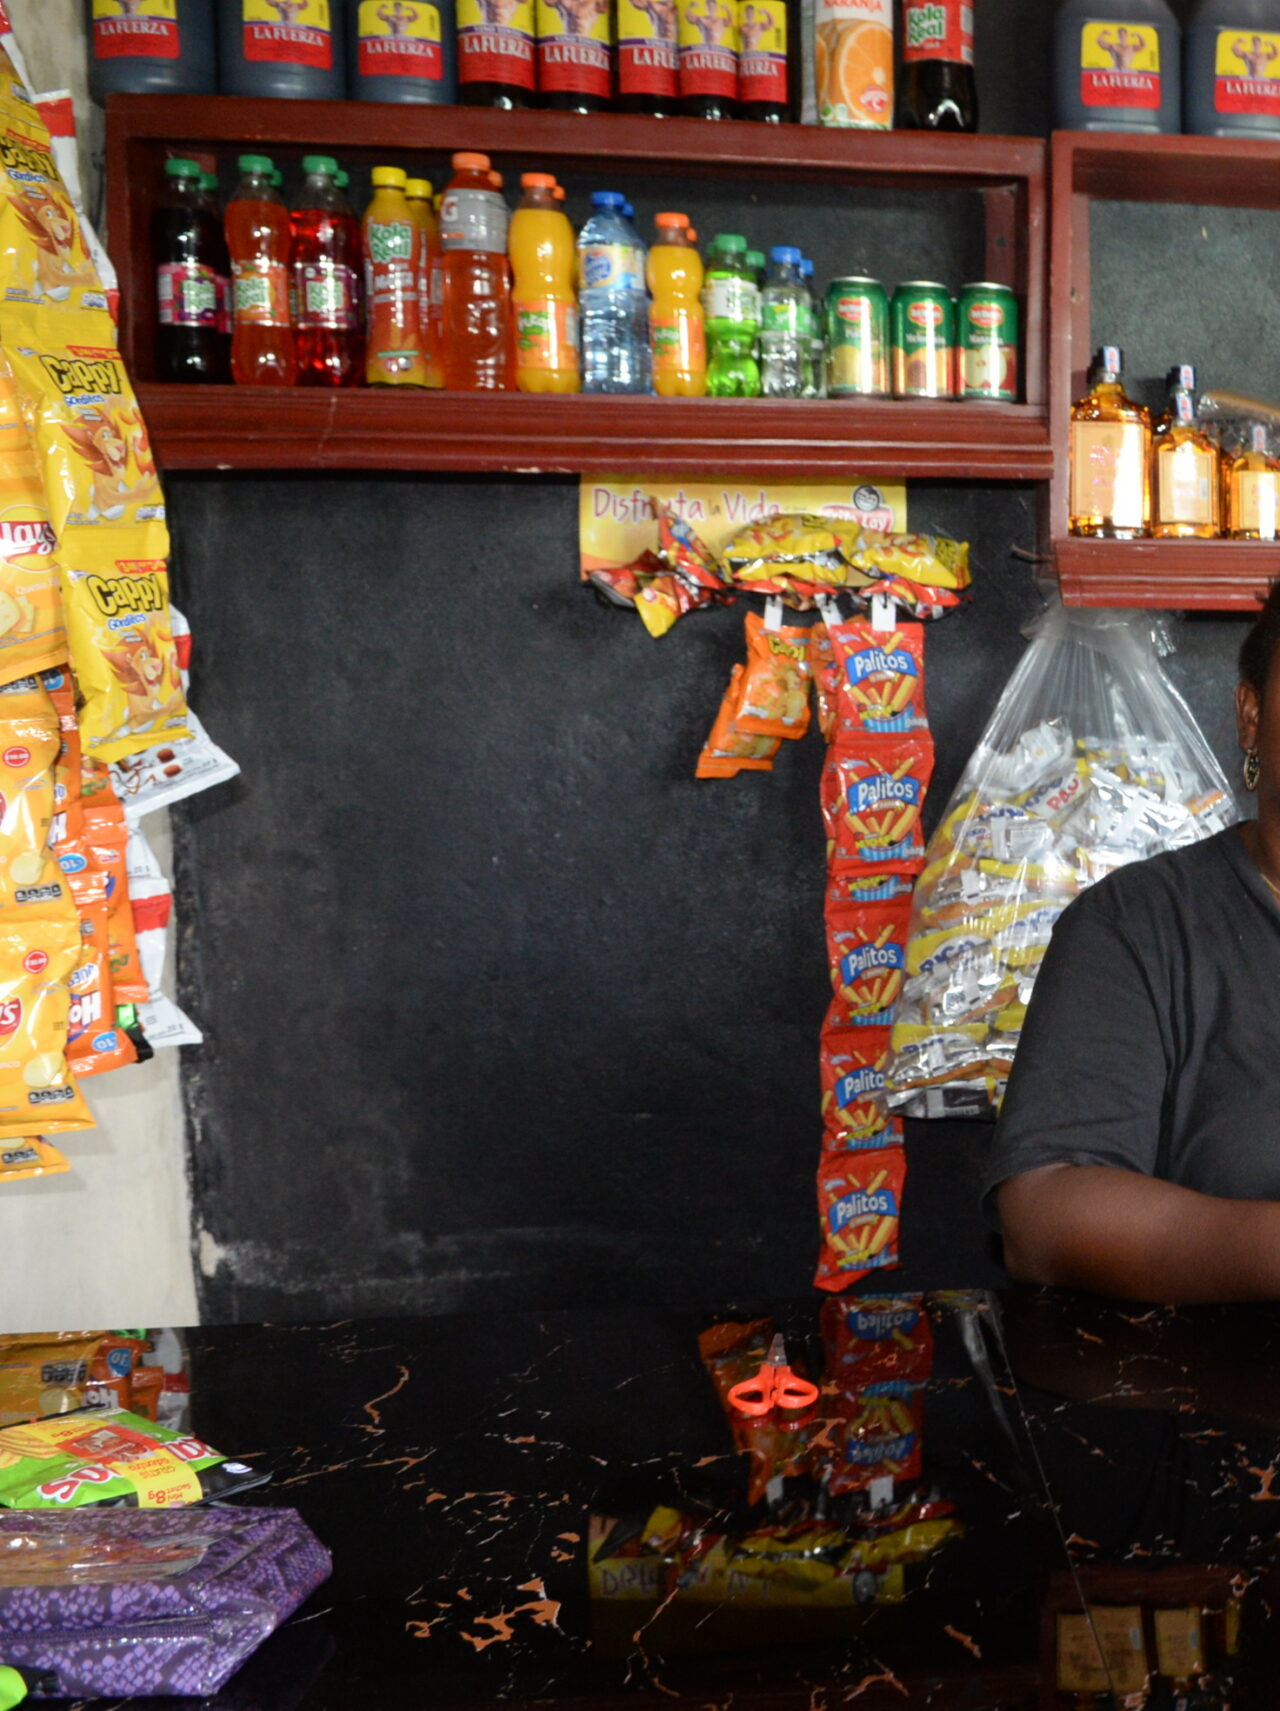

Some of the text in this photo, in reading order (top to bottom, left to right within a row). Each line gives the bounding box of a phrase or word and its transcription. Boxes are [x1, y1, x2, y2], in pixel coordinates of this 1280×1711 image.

[117, 22, 168, 36] FUERZA
[273, 28, 324, 47] FUERZA
[385, 42, 434, 57] FUERZA
[481, 38, 532, 61] FUERZA
[560, 46, 611, 71] FUERZA
[650, 49, 680, 69] FUE
[1109, 75, 1153, 91] FUERZA
[40, 354, 122, 395] Cappy
[86, 574, 165, 616] Cappy
[854, 650, 909, 677] Palitos
[859, 777, 914, 804] Palitos
[849, 947, 897, 972] Palitos
[844, 1069, 885, 1099] Palito
[836, 1194, 889, 1224] Palitos
